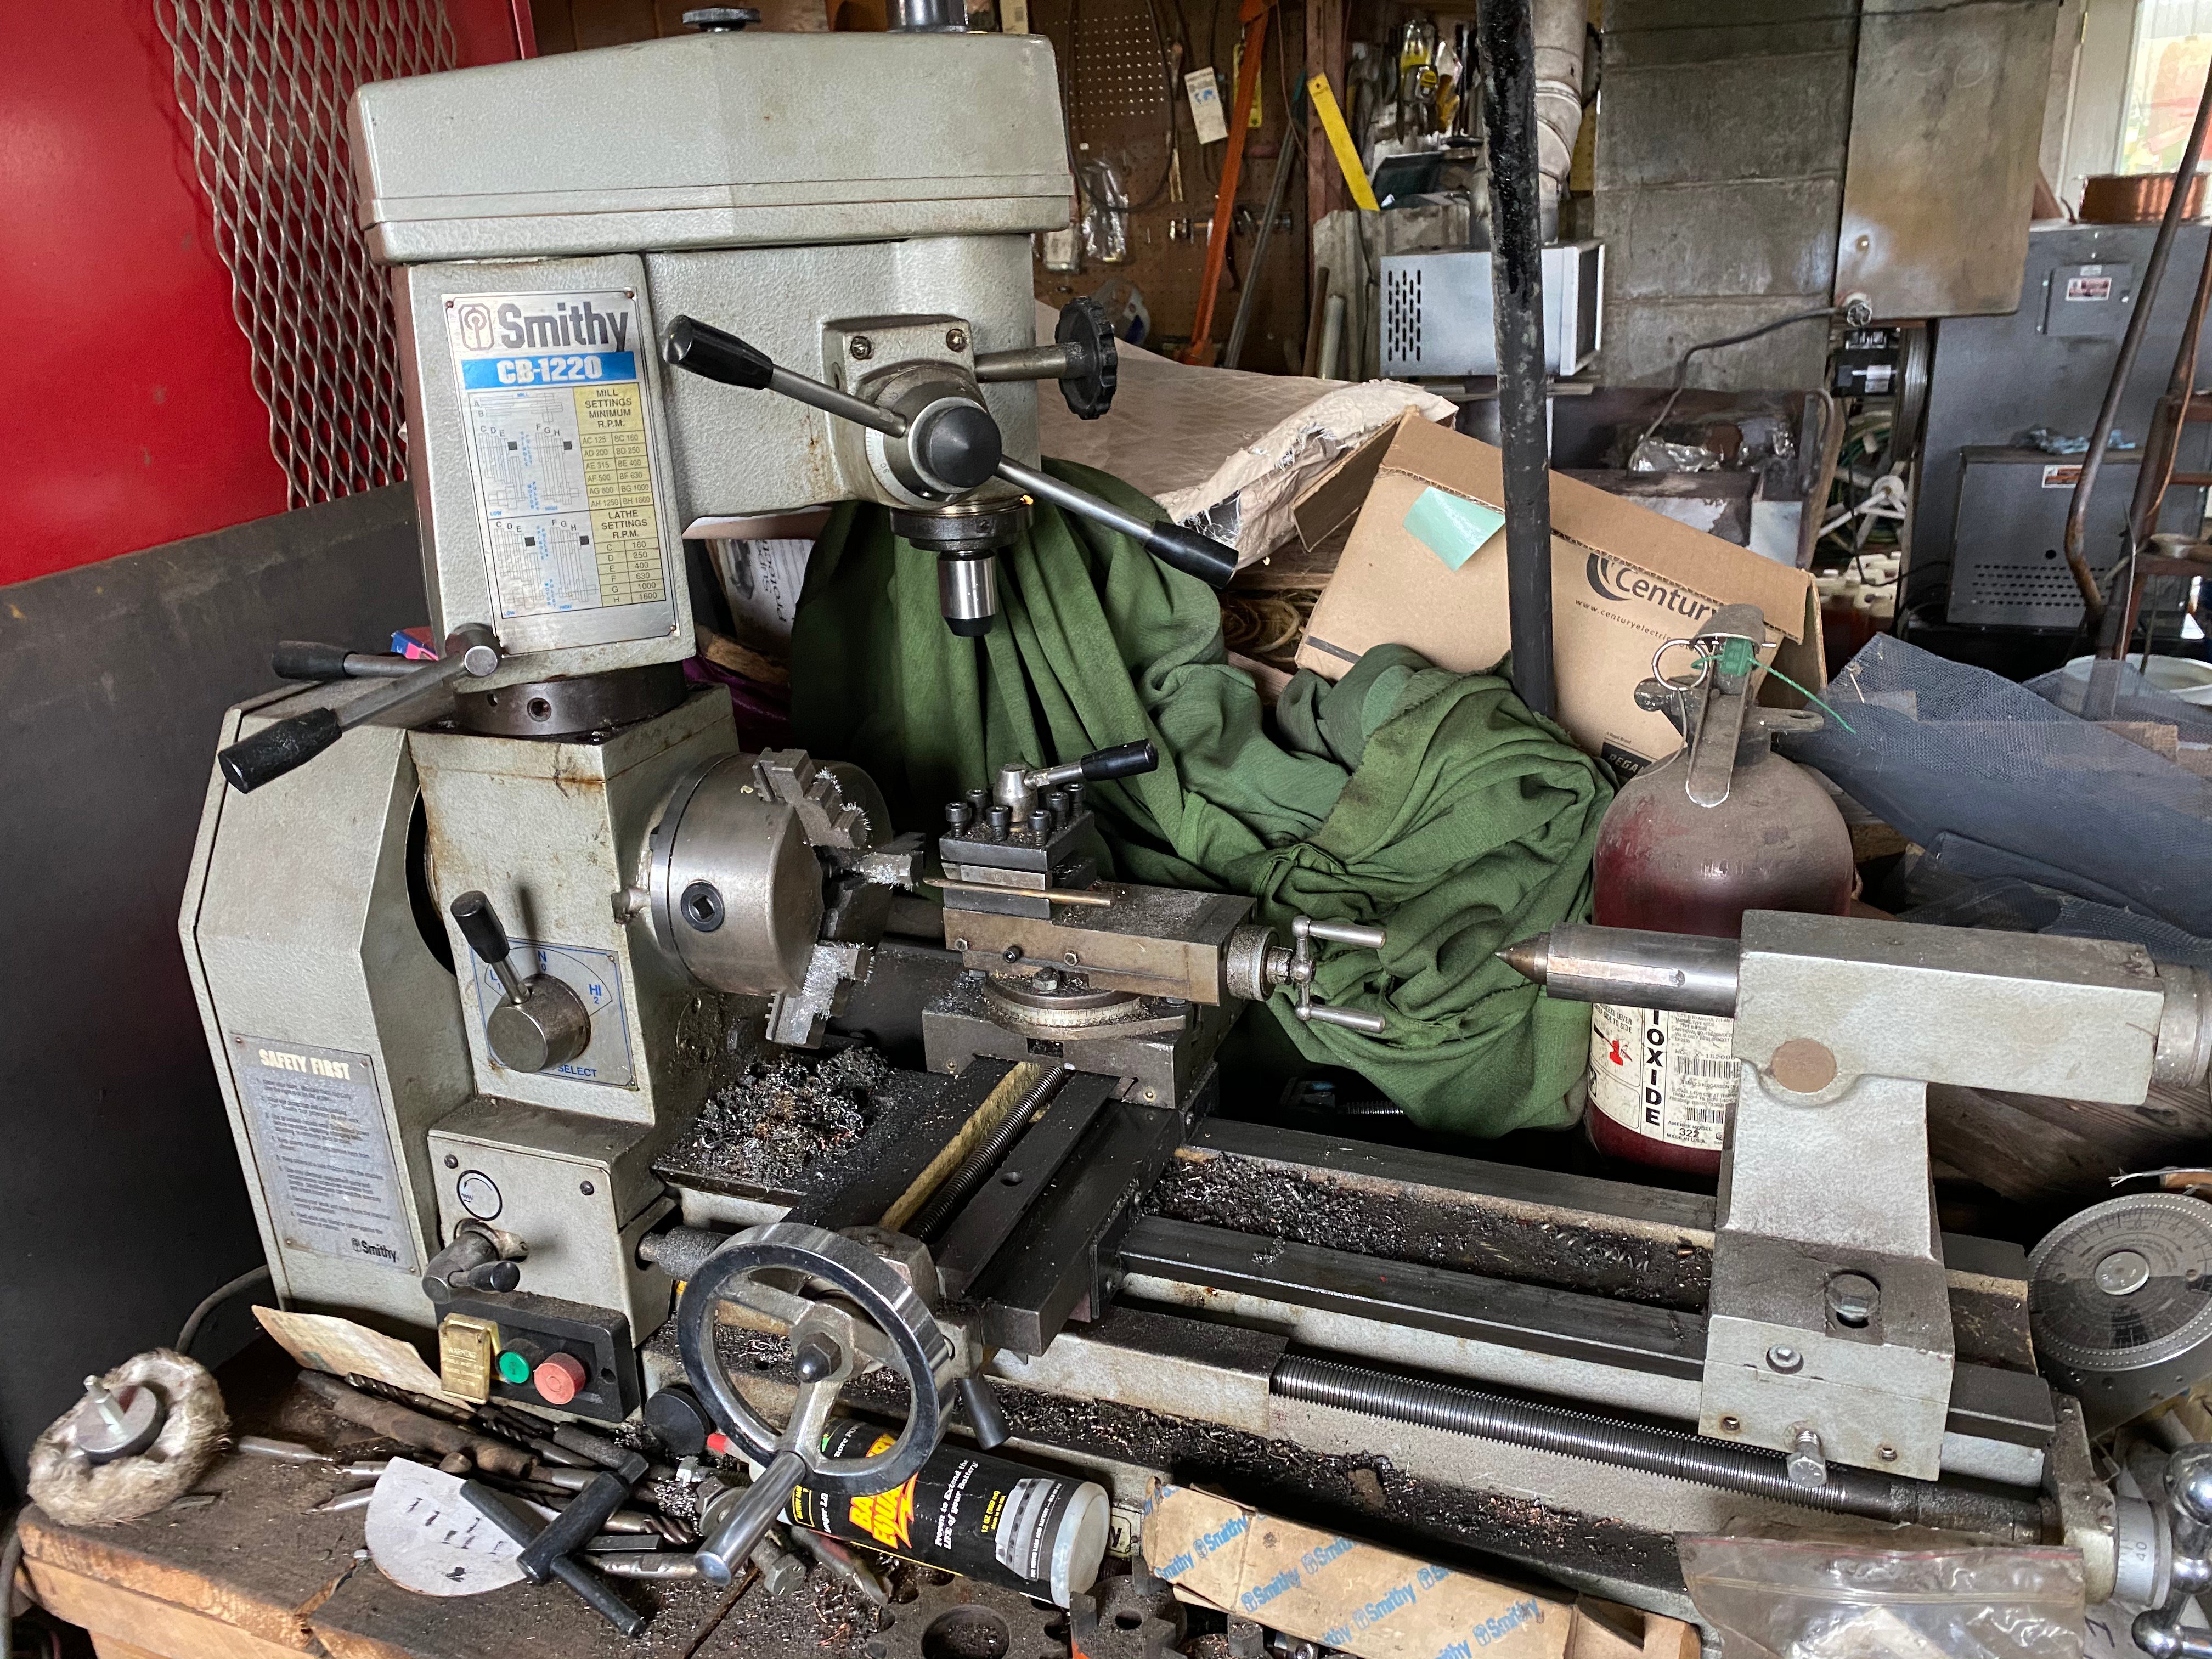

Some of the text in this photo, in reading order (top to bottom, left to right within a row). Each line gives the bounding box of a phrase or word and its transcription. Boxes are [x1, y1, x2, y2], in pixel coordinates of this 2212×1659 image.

[497, 302, 628, 352] Smithy
[497, 356, 603, 383] CB-1220
[596, 389, 618, 397] MILL
[585, 398, 632, 408] SETTINGS
[589, 408, 631, 418] MINIMUM
[597, 420, 625, 428] R.P.M.
[589, 487, 600, 495] AG
[591, 498, 619, 507] AH 1250
[623, 495, 651, 505] BH 1600
[608, 510, 638, 519] LATHE
[601, 519, 647, 530] SETTINGS
[613, 530, 639, 539] R.P.M.
[639, 592, 657, 600] 1600
[1608, 753, 1644, 772] REGA
[538, 950, 546, 962] N
[589, 984, 601, 996] HI
[1616, 1012, 1632, 1025] LEVER
[1613, 1018, 1619, 1026] TO
[1620, 1023, 1632, 1033] SIDE
[258, 1049, 351, 1080] SAFETY FIRST
[557, 1065, 597, 1077] SELECT
[1646, 1010, 1664, 1126] IOXIDE
[1679, 1128, 1700, 1138] 322
[361, 1240, 397, 1262] Smithy
[935, 1459, 969, 1547] Proven to Extend the
[951, 1491, 961, 1514] your
[947, 1513, 956, 1526] of
[1039, 1508, 1049, 1526] BATTERY
[981, 1525, 989, 1533] 12
[1203, 1515, 1248, 1551] Smithy
[944, 1527, 952, 1549] LIFE
[2136, 1542, 2147, 1561] 40
[1252, 1567, 1301, 1606] Smithy
[1365, 1582, 1417, 1622] Smithy
[1486, 1598, 1540, 1638] Smithy
